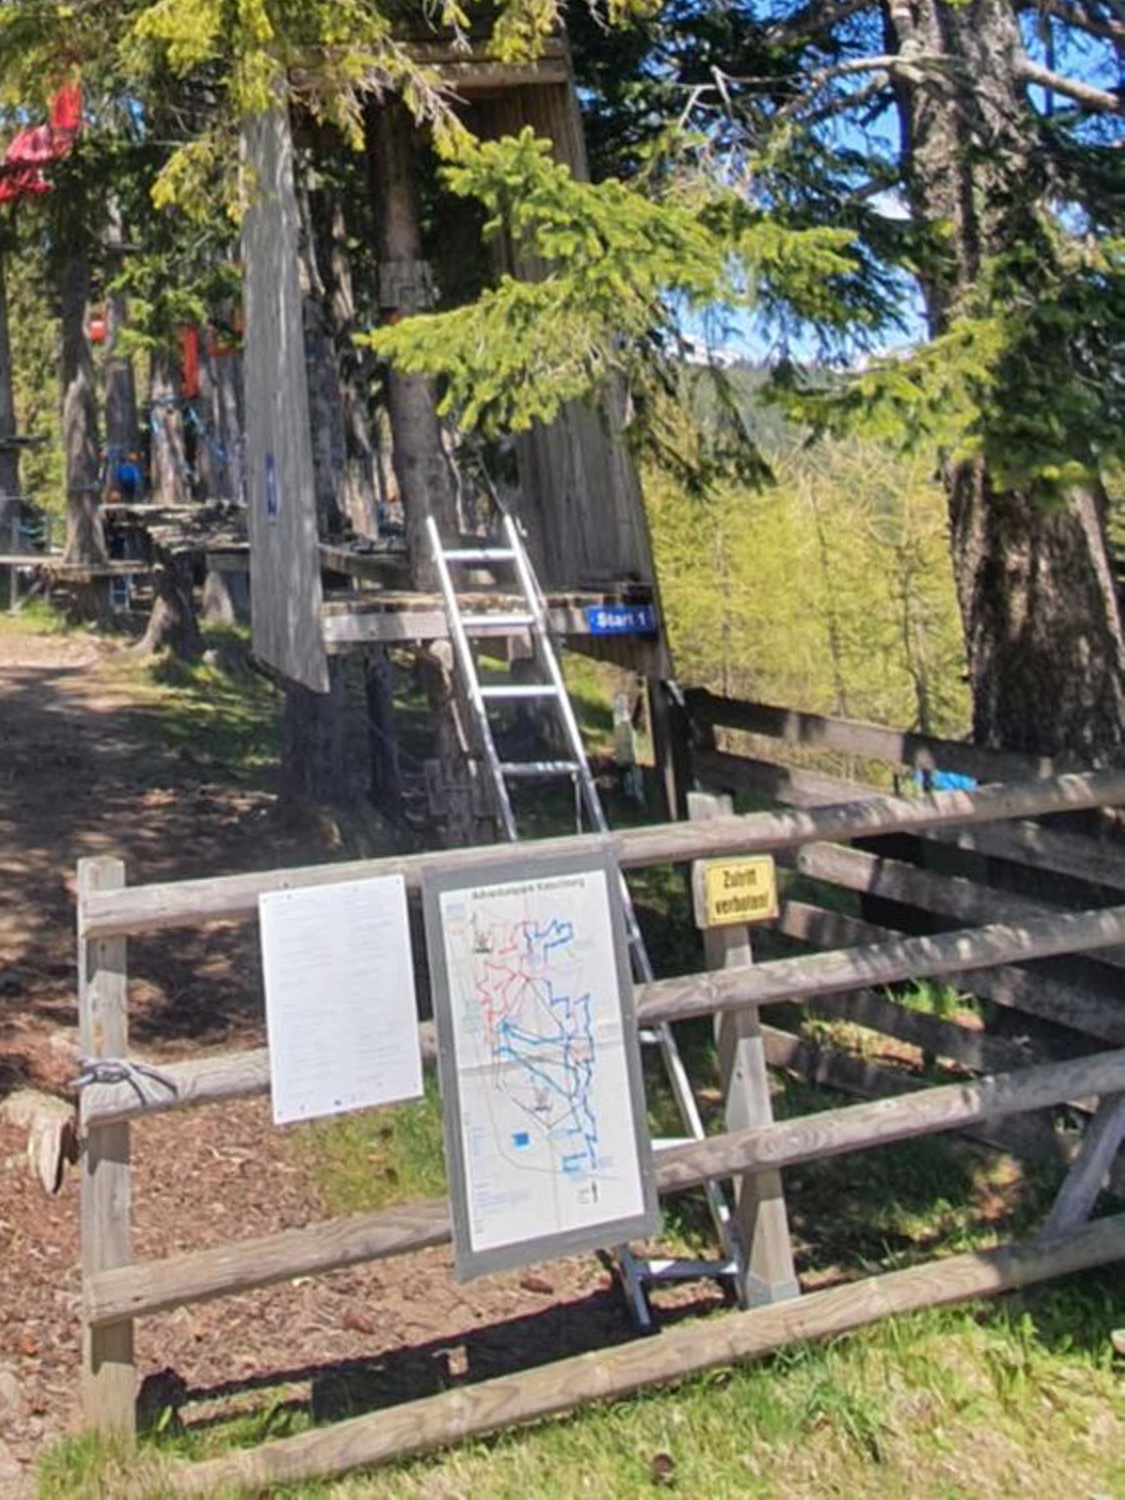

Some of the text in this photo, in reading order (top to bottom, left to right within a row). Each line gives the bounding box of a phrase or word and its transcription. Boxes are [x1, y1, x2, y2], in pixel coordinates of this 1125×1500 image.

[597, 611, 646, 628] Start 1
[722, 869, 757, 889] Zutritt
